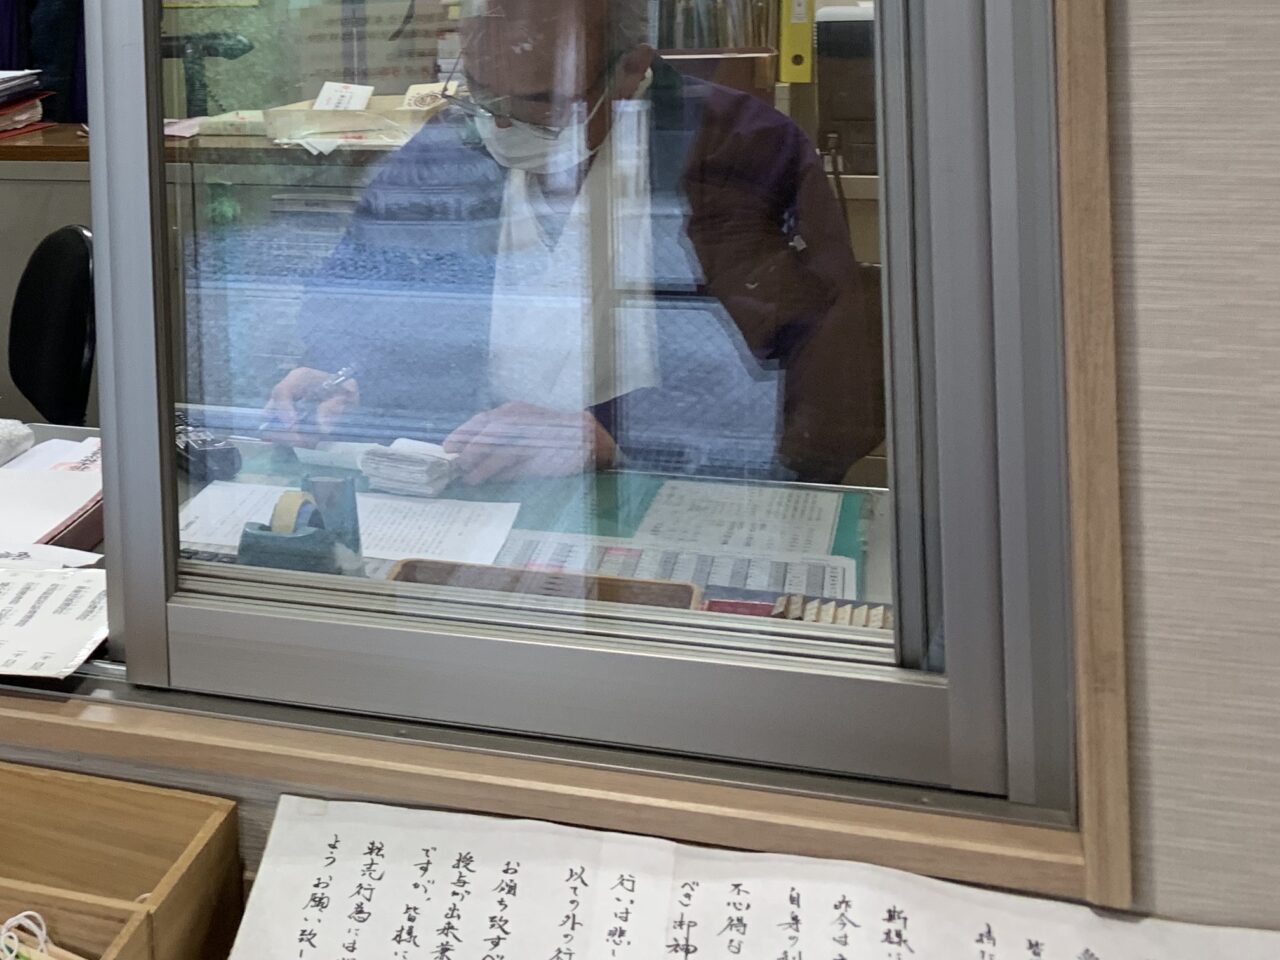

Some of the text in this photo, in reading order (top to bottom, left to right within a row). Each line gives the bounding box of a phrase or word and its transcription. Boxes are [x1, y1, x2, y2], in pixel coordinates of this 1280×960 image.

[335, 840, 385, 960] 転売行為には
